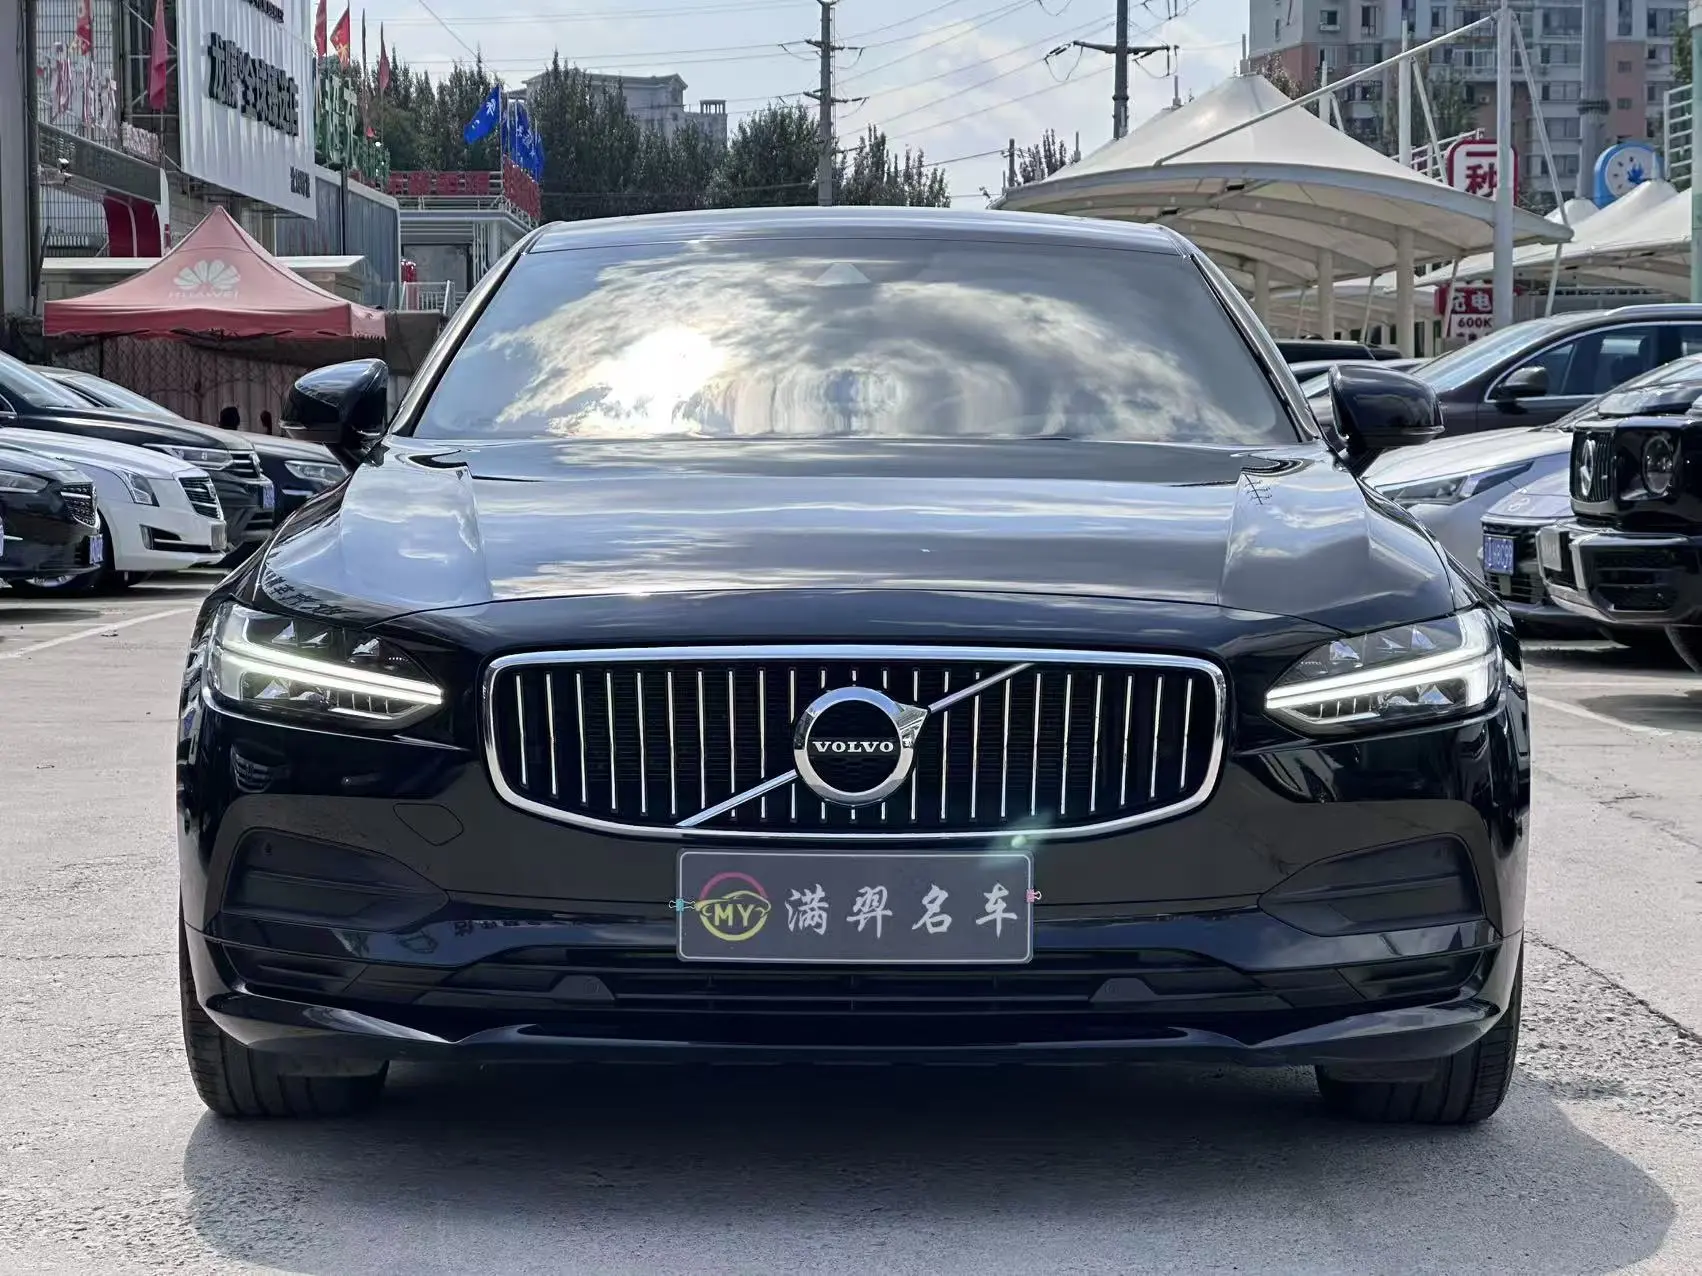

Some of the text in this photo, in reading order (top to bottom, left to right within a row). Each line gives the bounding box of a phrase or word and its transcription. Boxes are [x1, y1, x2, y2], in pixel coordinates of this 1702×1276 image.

[812, 741, 894, 753] VOLVO
[714, 905, 755, 927] MY
[784, 883, 1018, 939] 满羿名车
